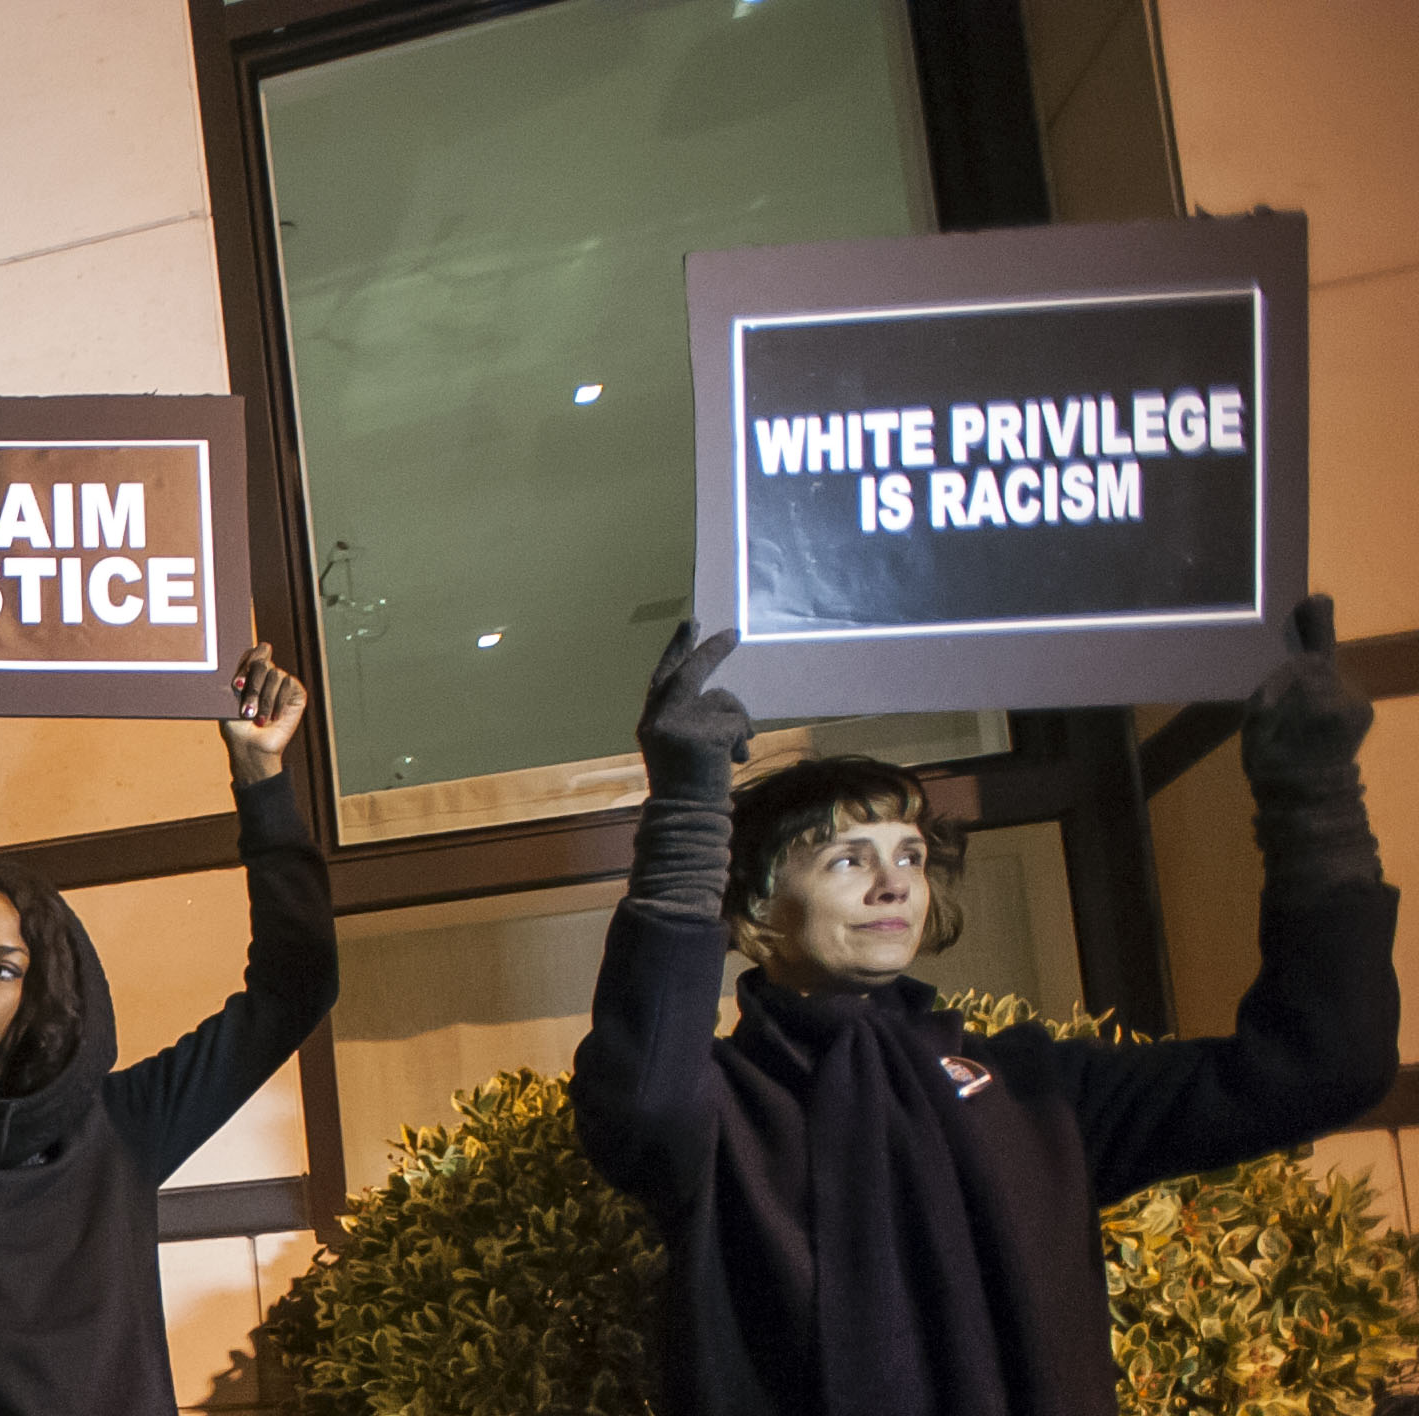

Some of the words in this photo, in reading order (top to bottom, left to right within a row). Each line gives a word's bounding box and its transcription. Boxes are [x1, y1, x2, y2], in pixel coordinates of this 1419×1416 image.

[753, 408, 936, 477] WHITE
[950, 391, 1244, 465] PRIVILEGE
[859, 472, 915, 534] IS
[929, 460, 1141, 529] RACISM
